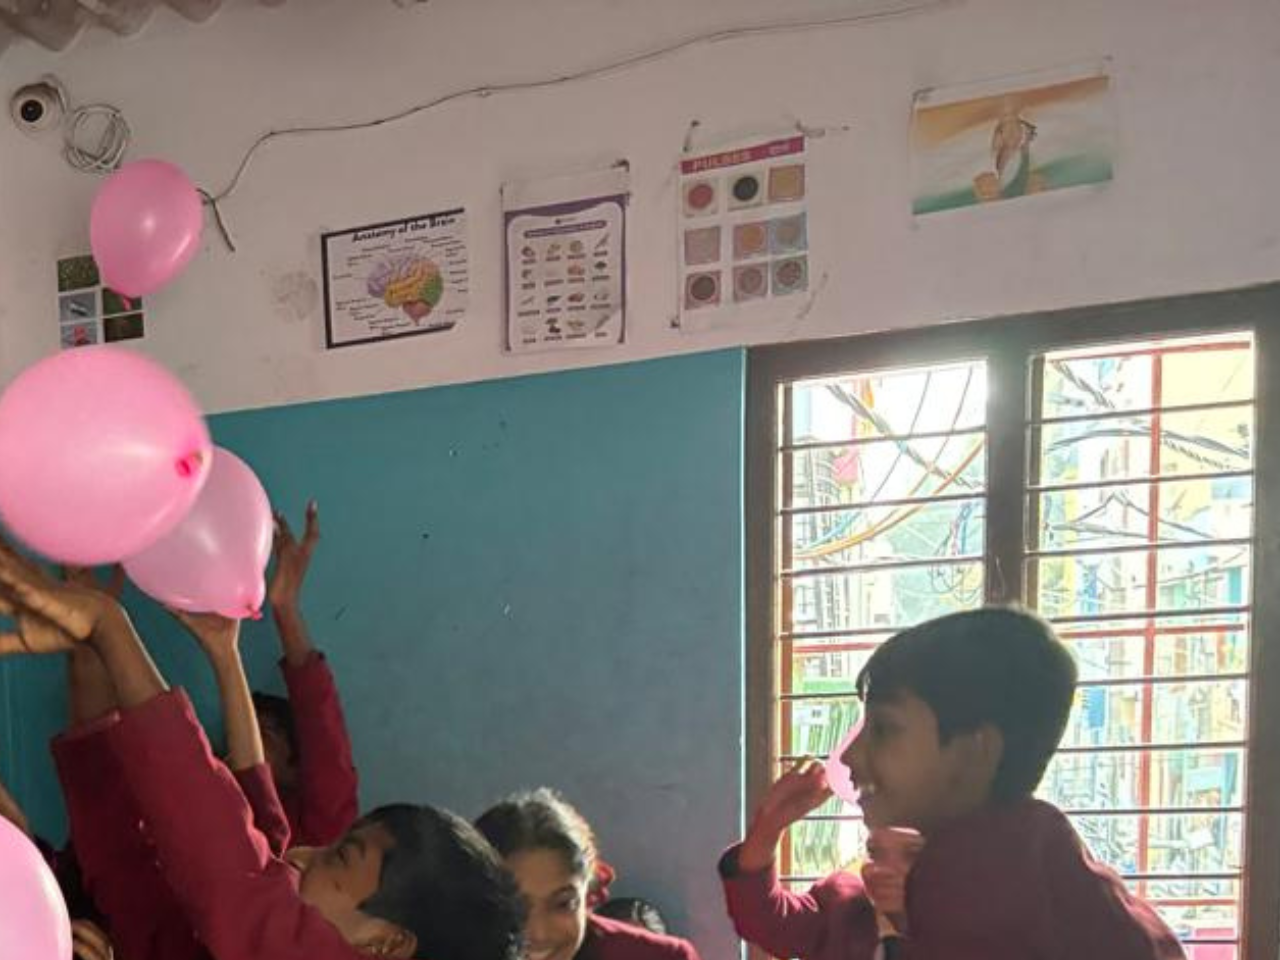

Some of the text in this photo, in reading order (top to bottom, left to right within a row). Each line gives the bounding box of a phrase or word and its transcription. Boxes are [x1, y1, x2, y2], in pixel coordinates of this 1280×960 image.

[352, 228, 396, 243] Anatomy
[398, 219, 408, 233] of
[411, 220, 427, 232] the
